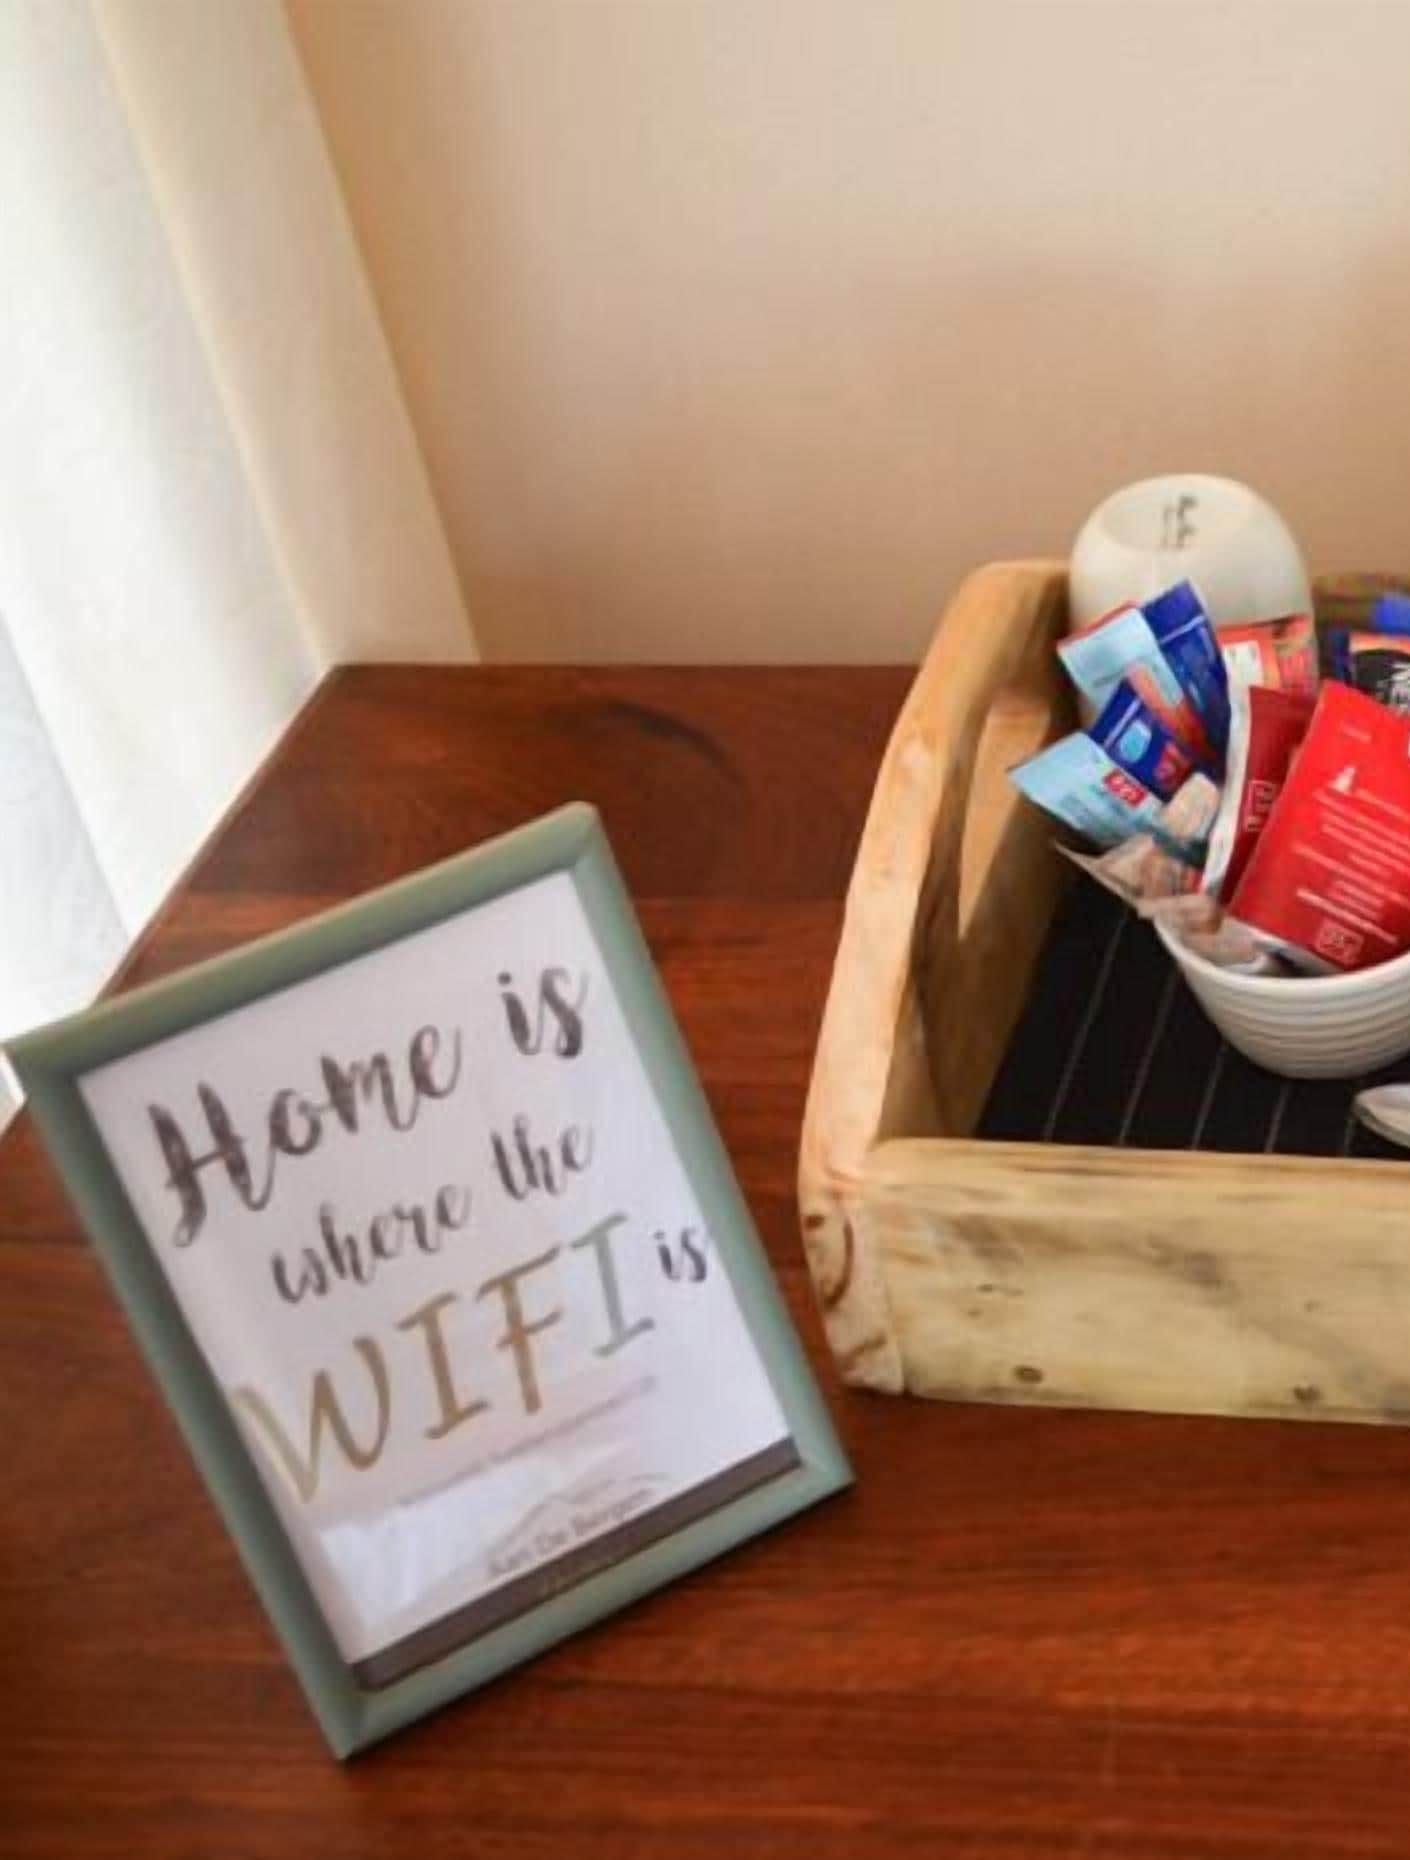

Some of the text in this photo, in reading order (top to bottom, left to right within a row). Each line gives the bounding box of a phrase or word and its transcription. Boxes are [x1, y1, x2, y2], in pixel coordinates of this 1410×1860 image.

[148, 966, 592, 1250] Home is
[270, 1114, 596, 1303] where the
[232, 1210, 656, 1504] WIFI
[653, 1226, 707, 1283] is
